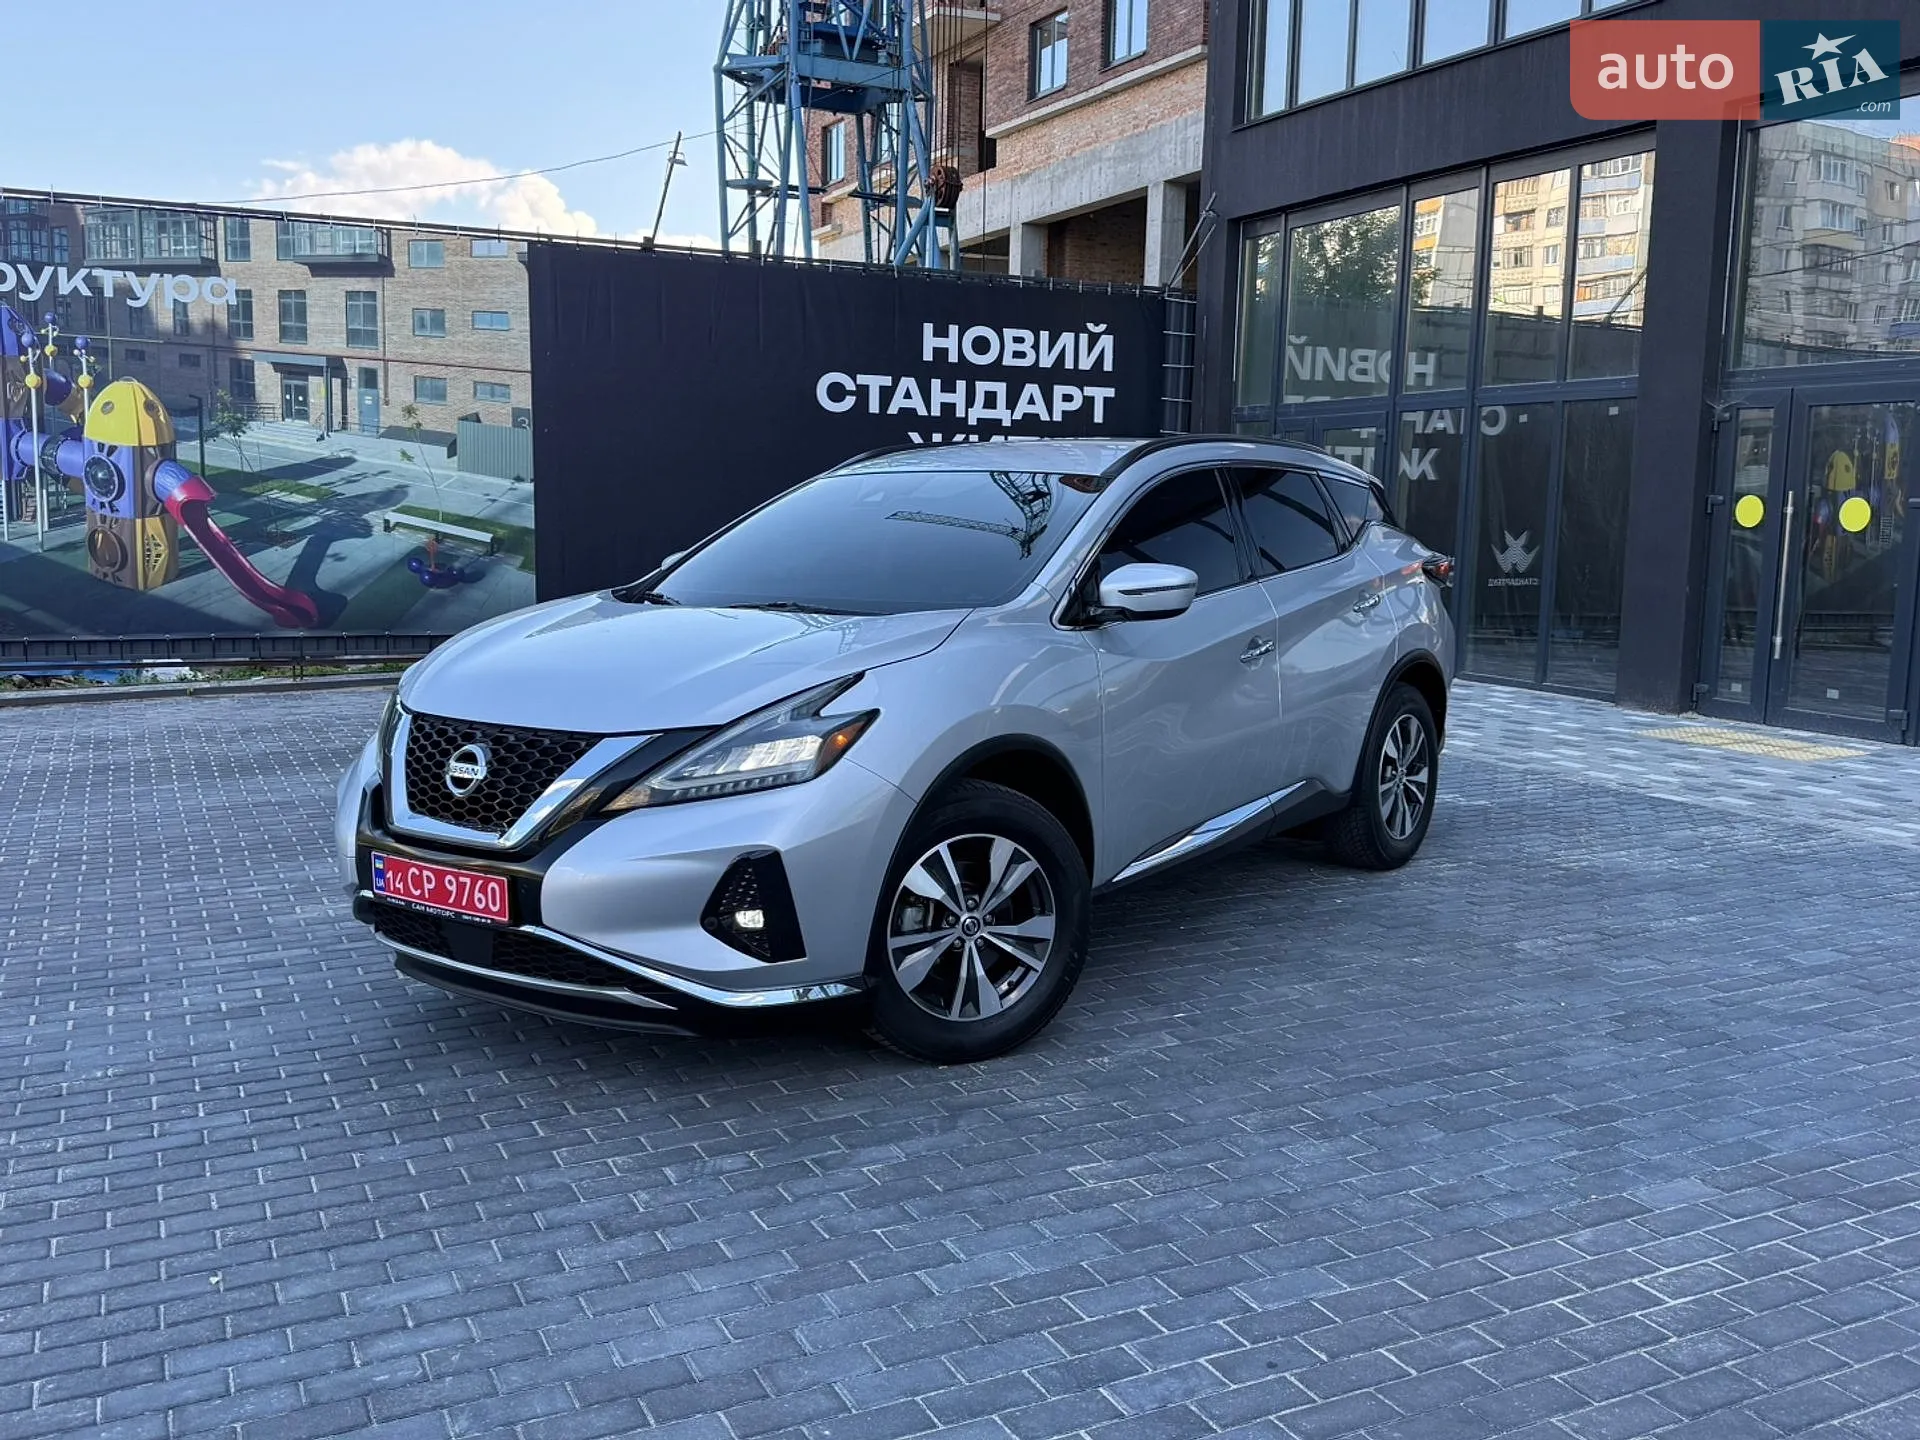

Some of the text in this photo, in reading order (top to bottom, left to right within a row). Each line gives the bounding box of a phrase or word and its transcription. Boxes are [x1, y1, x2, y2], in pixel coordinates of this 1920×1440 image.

[922, 322, 1115, 372] НОВИЙ
[815, 371, 1116, 427] СТАНДАРТ
[449, 764, 480, 777] SSAN
[444, 874, 500, 912] 9760
